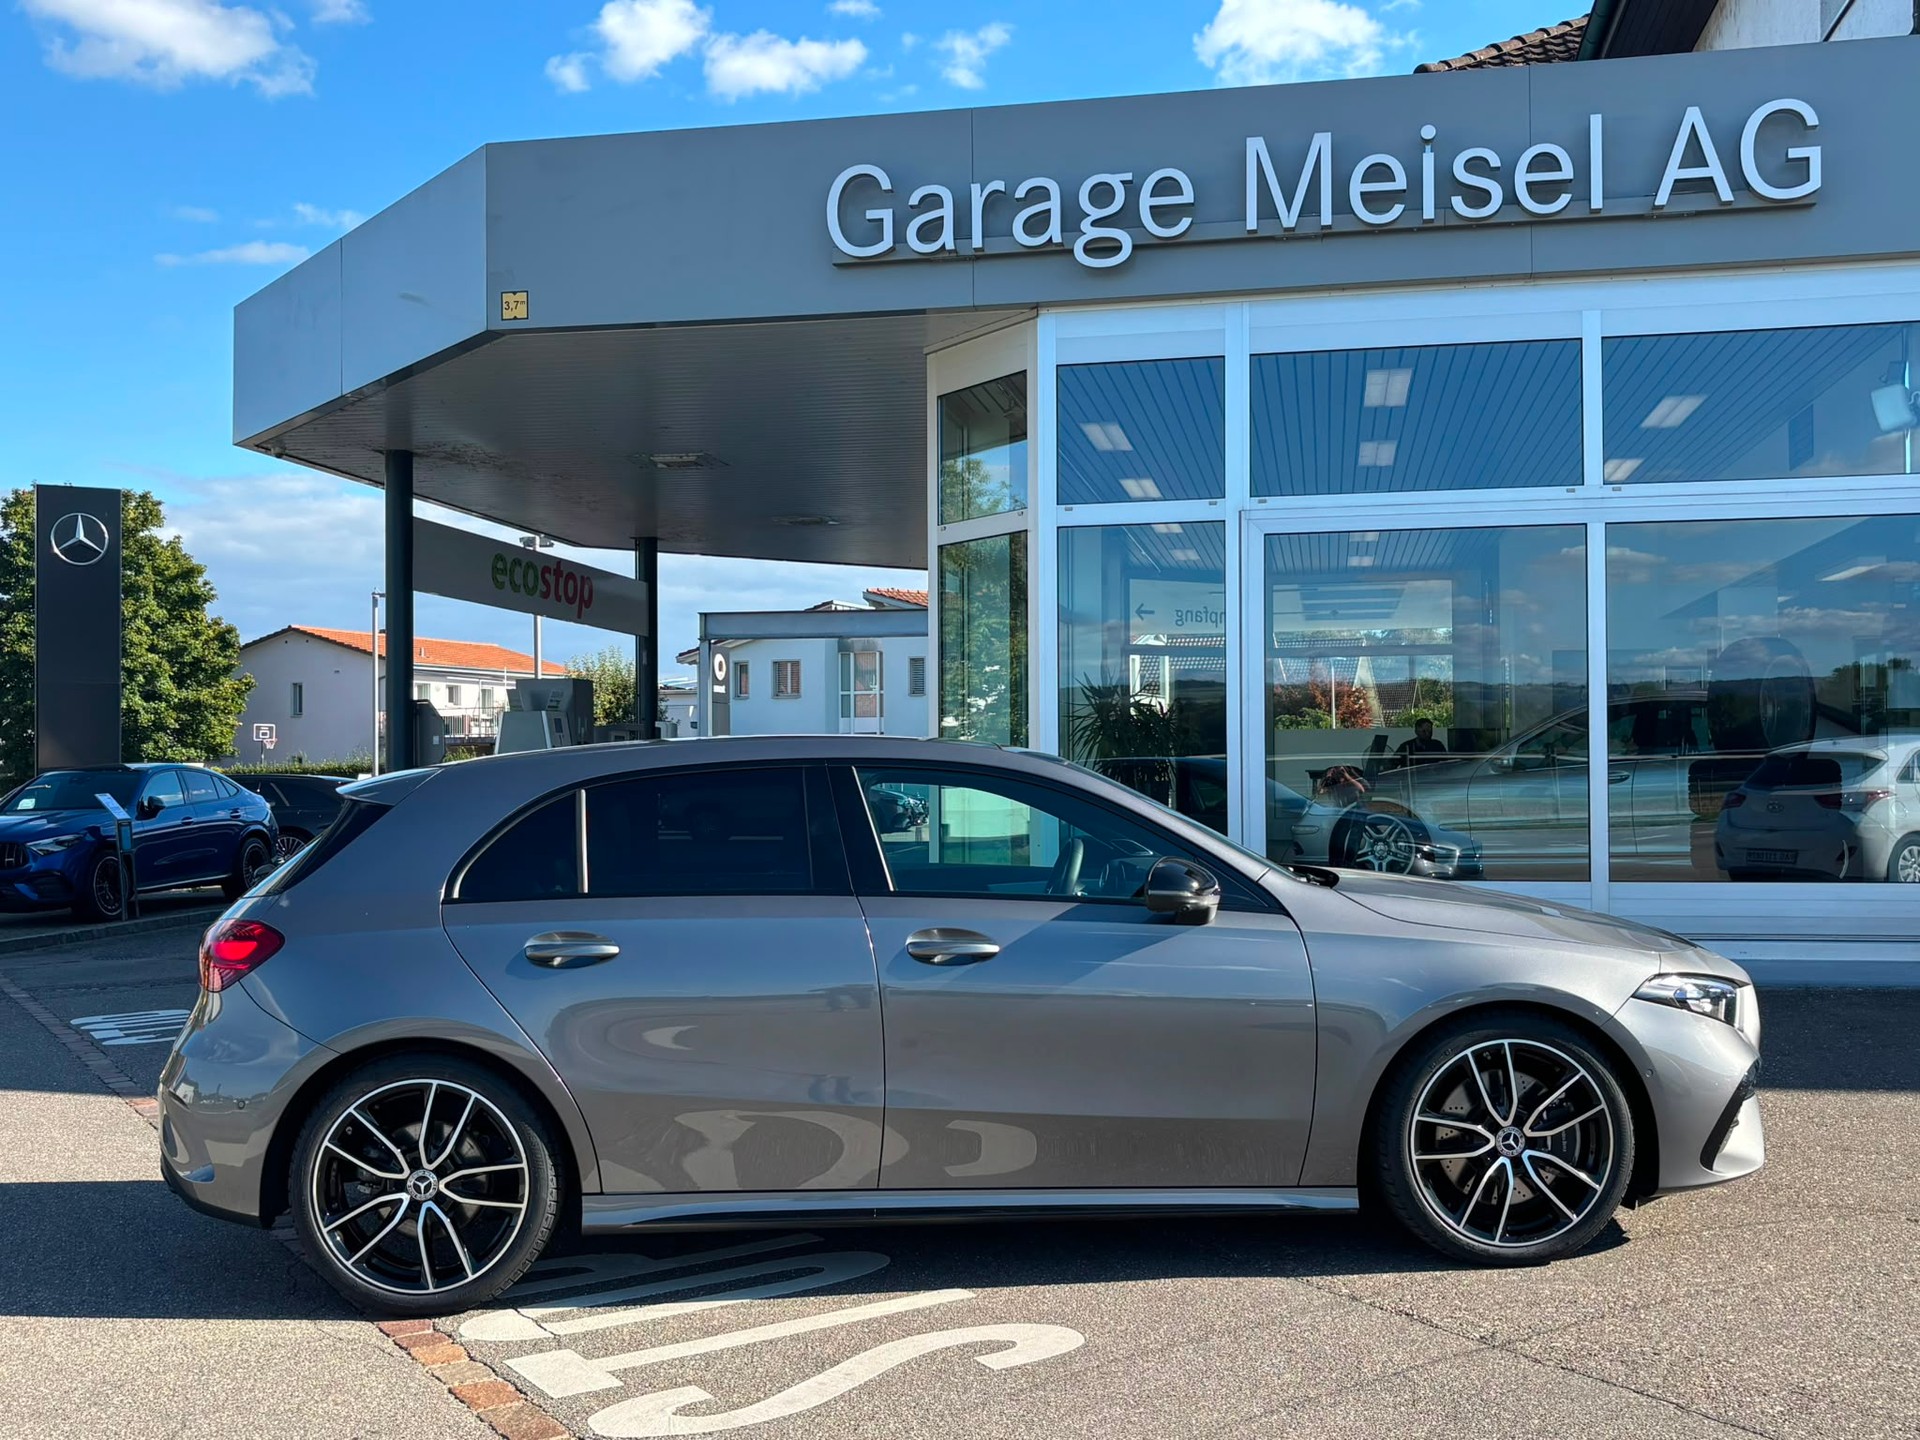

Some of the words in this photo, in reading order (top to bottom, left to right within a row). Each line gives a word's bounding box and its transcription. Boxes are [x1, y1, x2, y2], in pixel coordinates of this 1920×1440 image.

[826, 163, 1195, 269] Garage
[1245, 113, 1603, 232] Meisel
[1653, 98, 1823, 207] AG
[491, 552, 594, 619] ecostop
